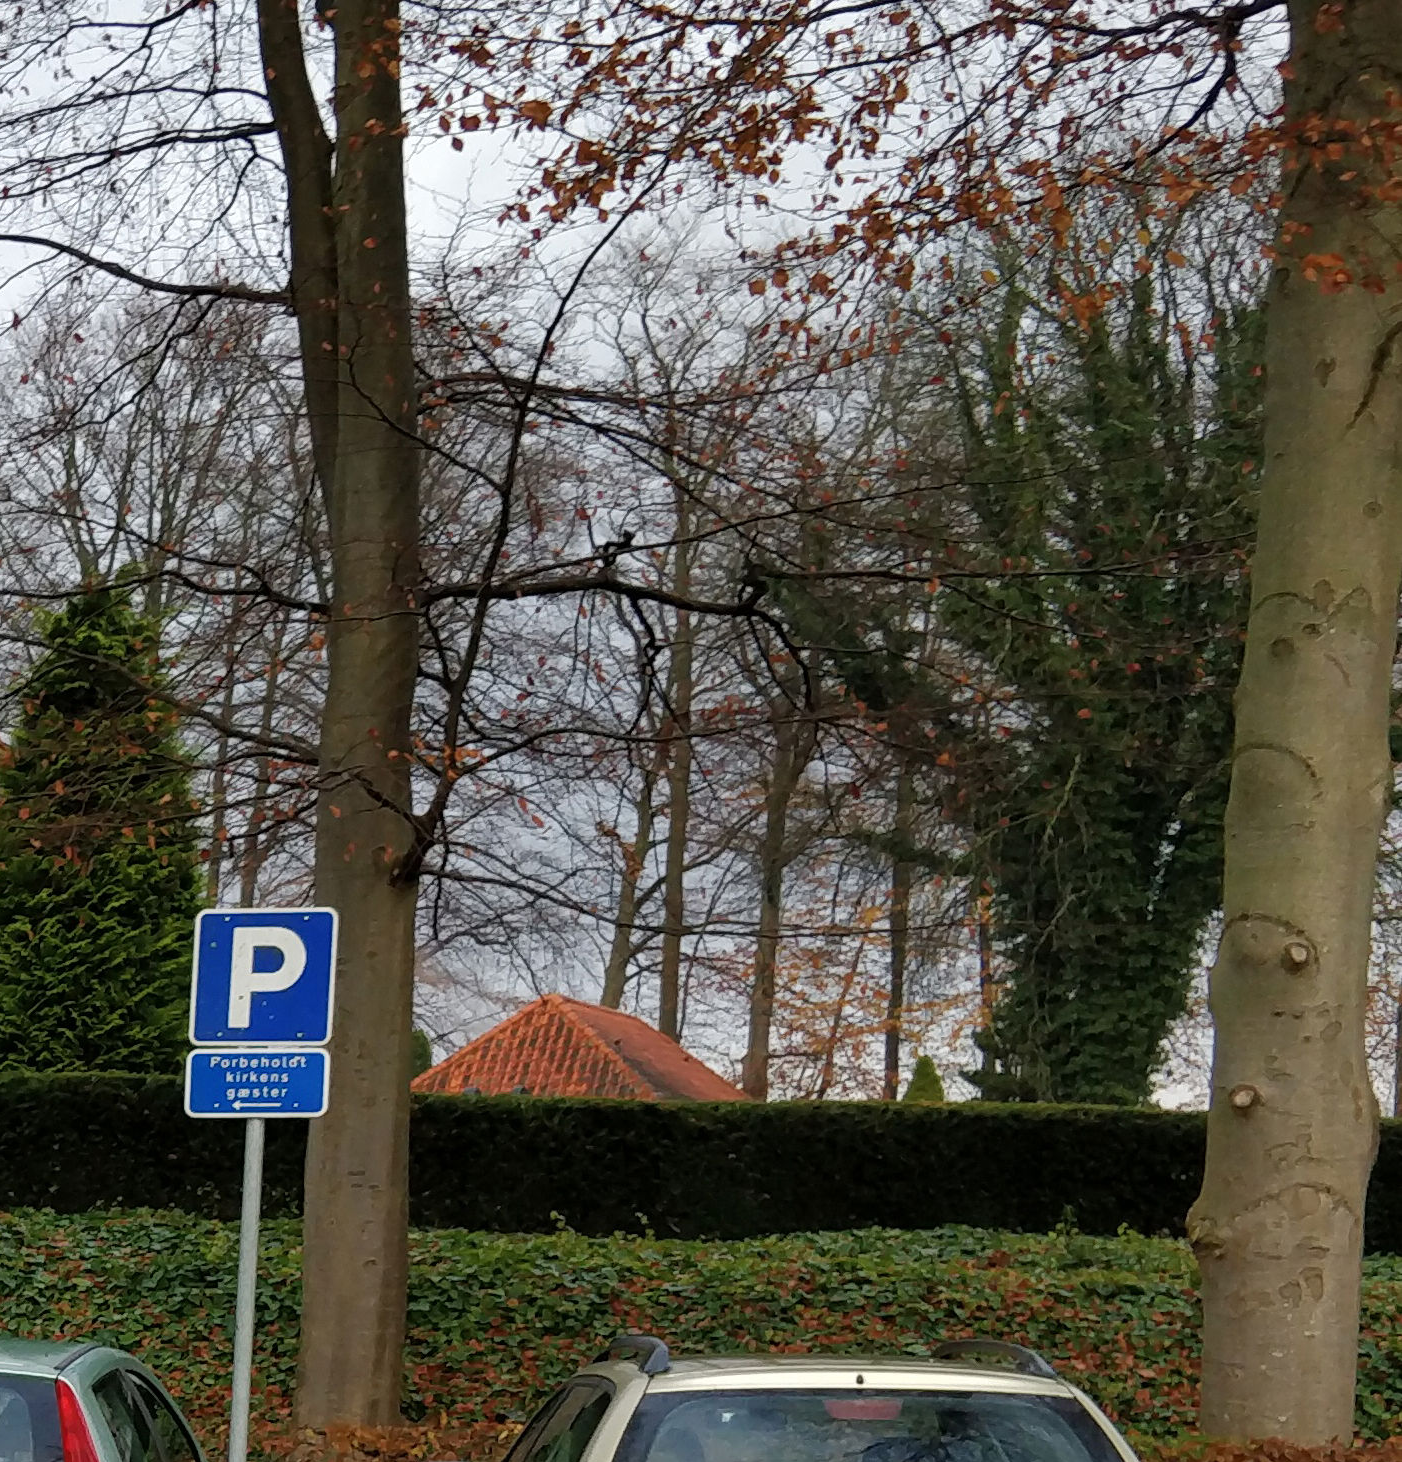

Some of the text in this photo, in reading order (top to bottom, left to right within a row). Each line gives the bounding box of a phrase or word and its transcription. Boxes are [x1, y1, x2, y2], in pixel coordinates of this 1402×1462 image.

[227, 926, 307, 1029] P
[209, 1056, 307, 1069] Forbeholdt
[225, 1071, 289, 1083] kirkens
[226, 1086, 288, 1101] gæster
